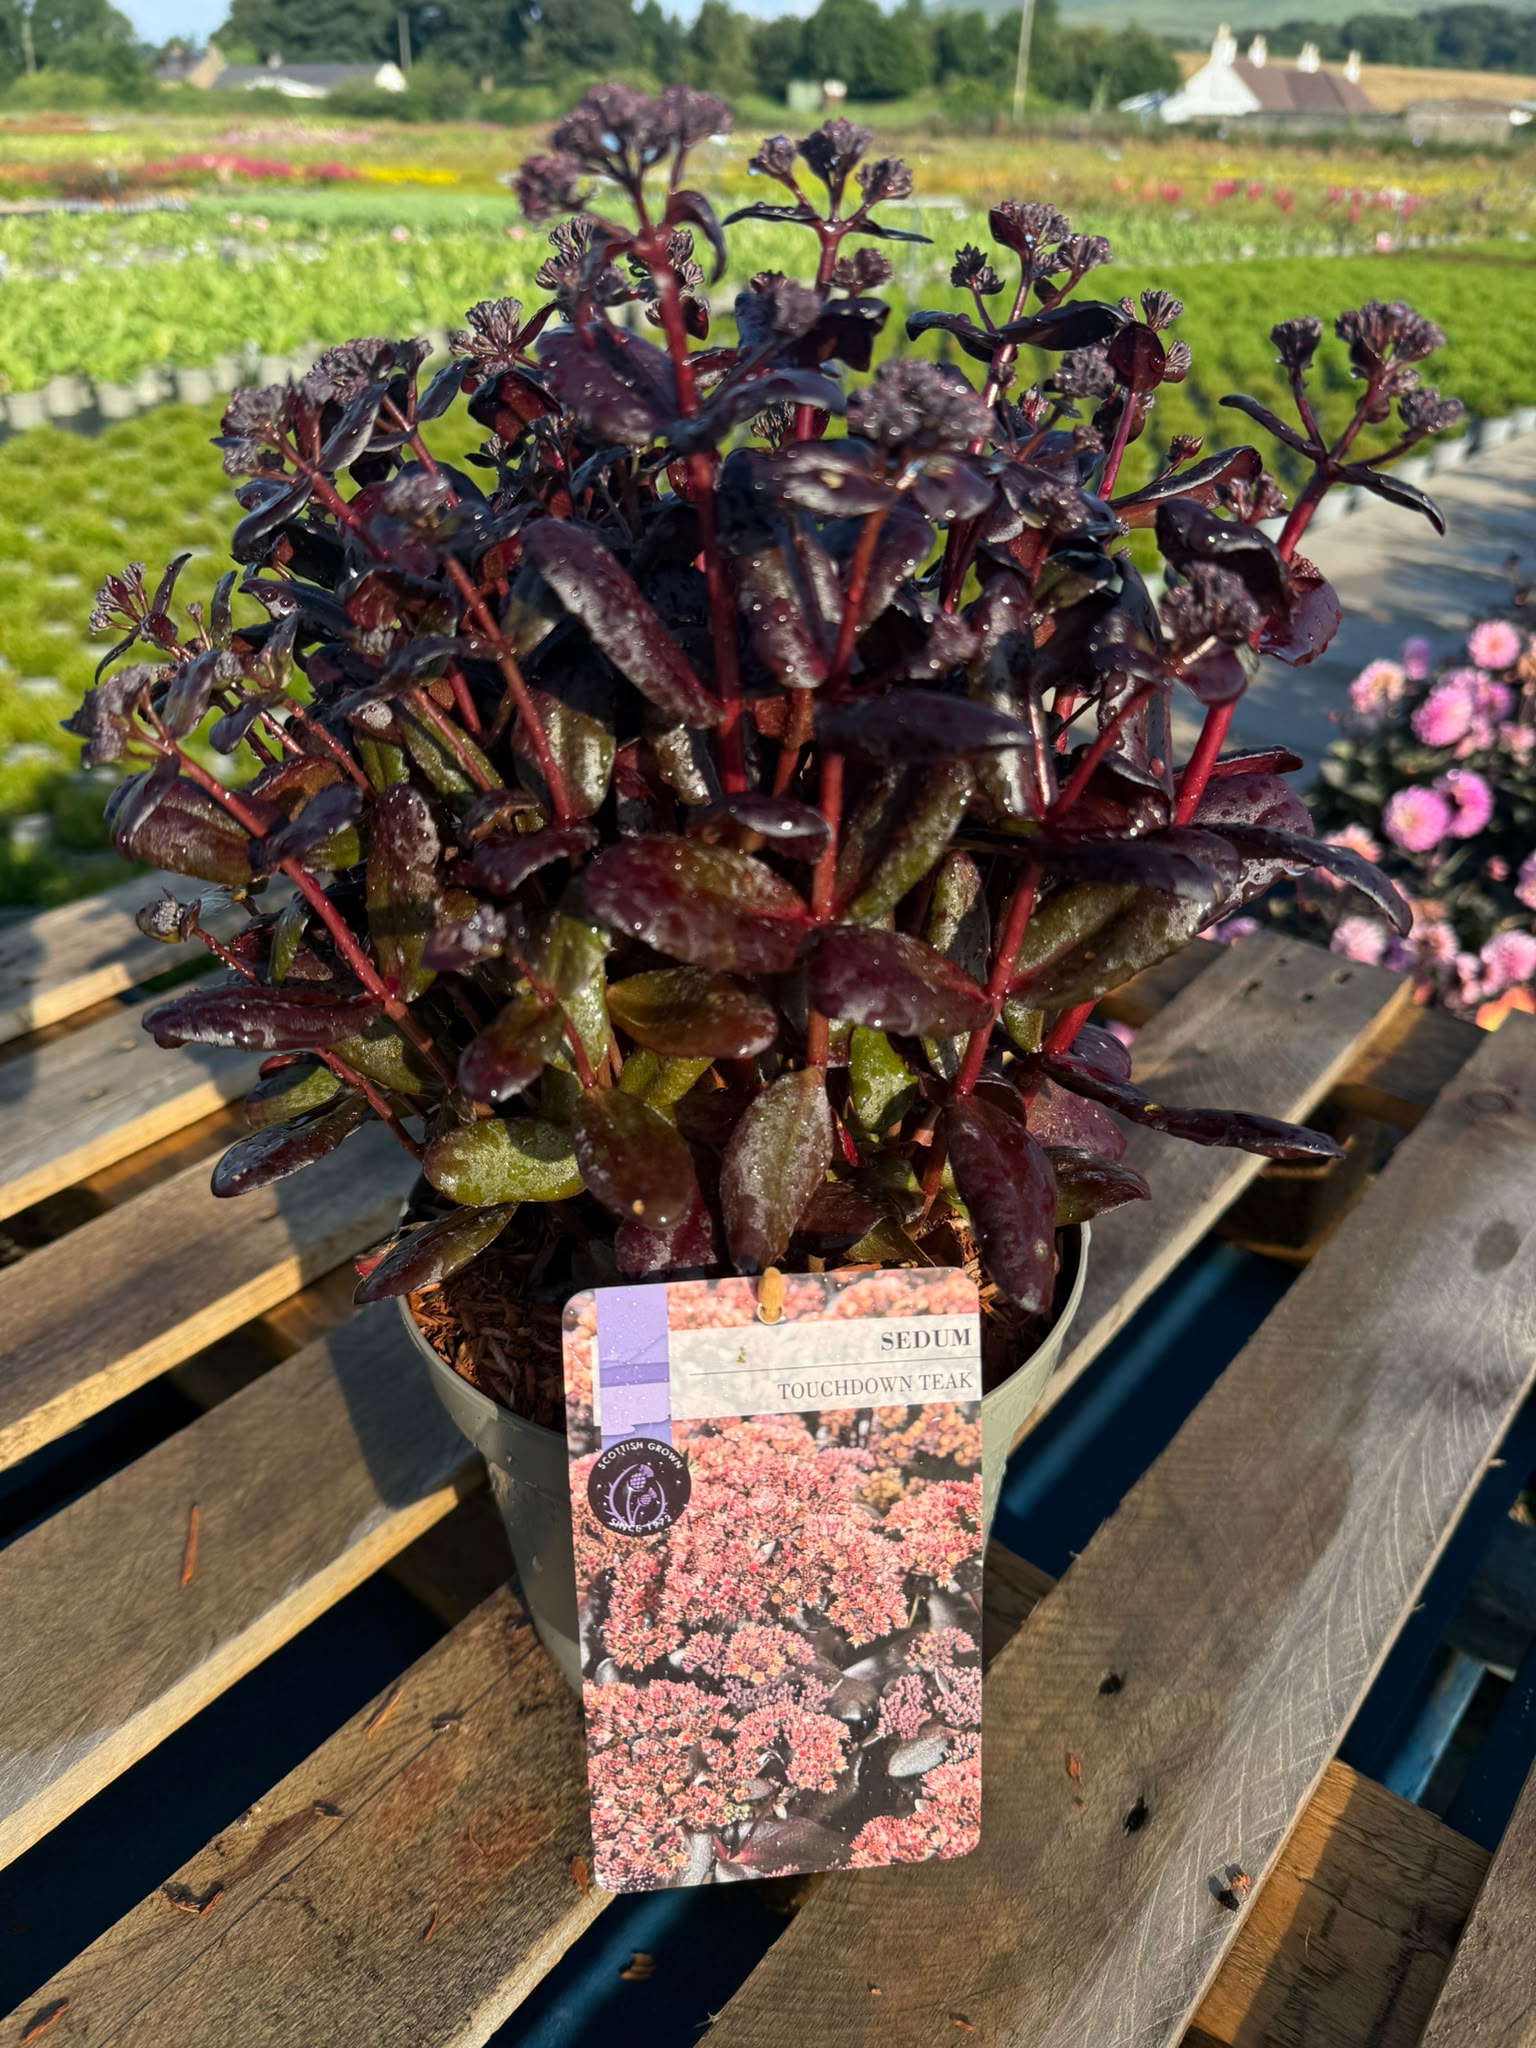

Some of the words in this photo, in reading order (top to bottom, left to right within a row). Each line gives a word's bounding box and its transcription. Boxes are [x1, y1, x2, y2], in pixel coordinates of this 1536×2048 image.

[880, 1327, 973, 1352] SEDUM
[777, 1374, 913, 1401] TOUCHDOWN
[918, 1371, 974, 1392] TEAK
[597, 1441, 644, 1470] SCOTTISH
[647, 1442, 684, 1470] GROWN
[608, 1517, 643, 1533] SINCE
[646, 1514, 673, 1531] 1972
